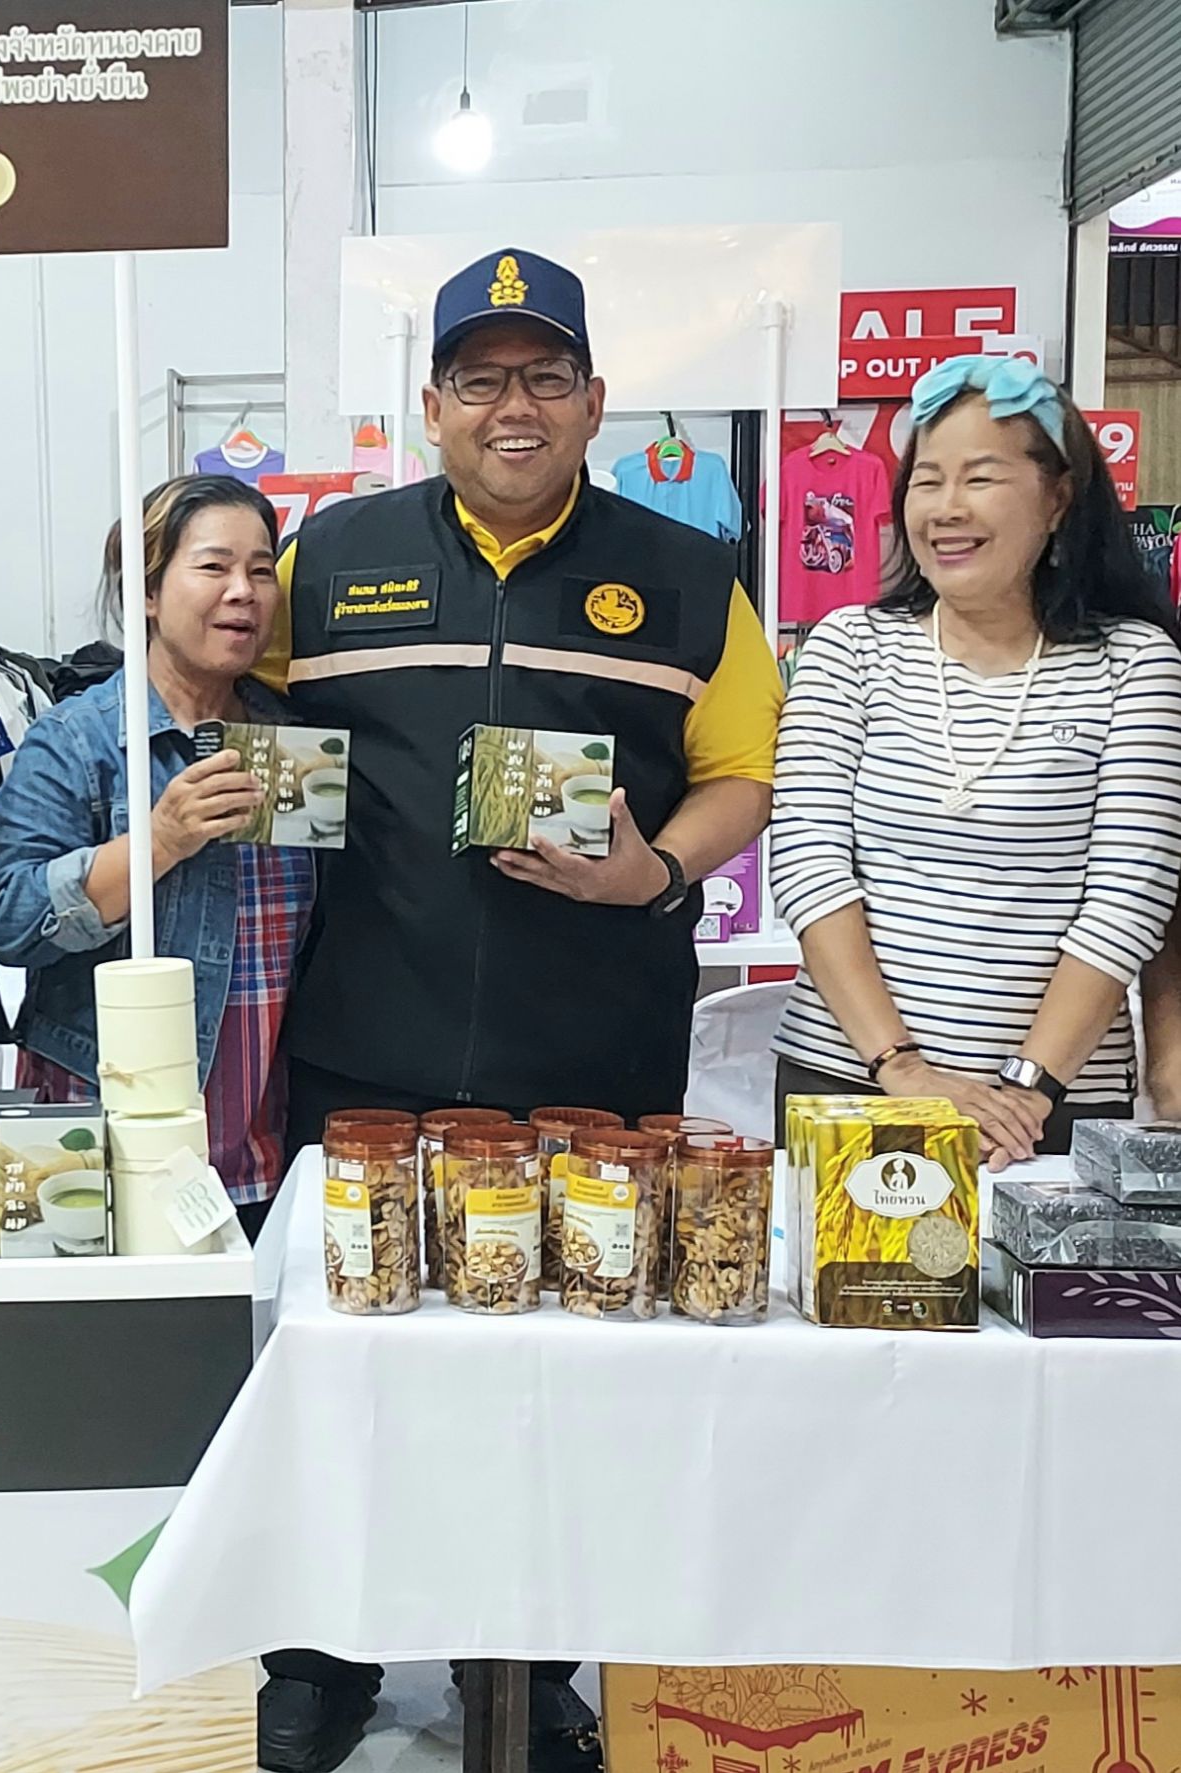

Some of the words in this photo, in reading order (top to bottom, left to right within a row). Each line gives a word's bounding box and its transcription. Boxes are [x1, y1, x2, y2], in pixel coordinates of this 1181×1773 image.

[867, 358, 922, 378] OUT
[873, 1188, 926, 1205] ไทยพวน
